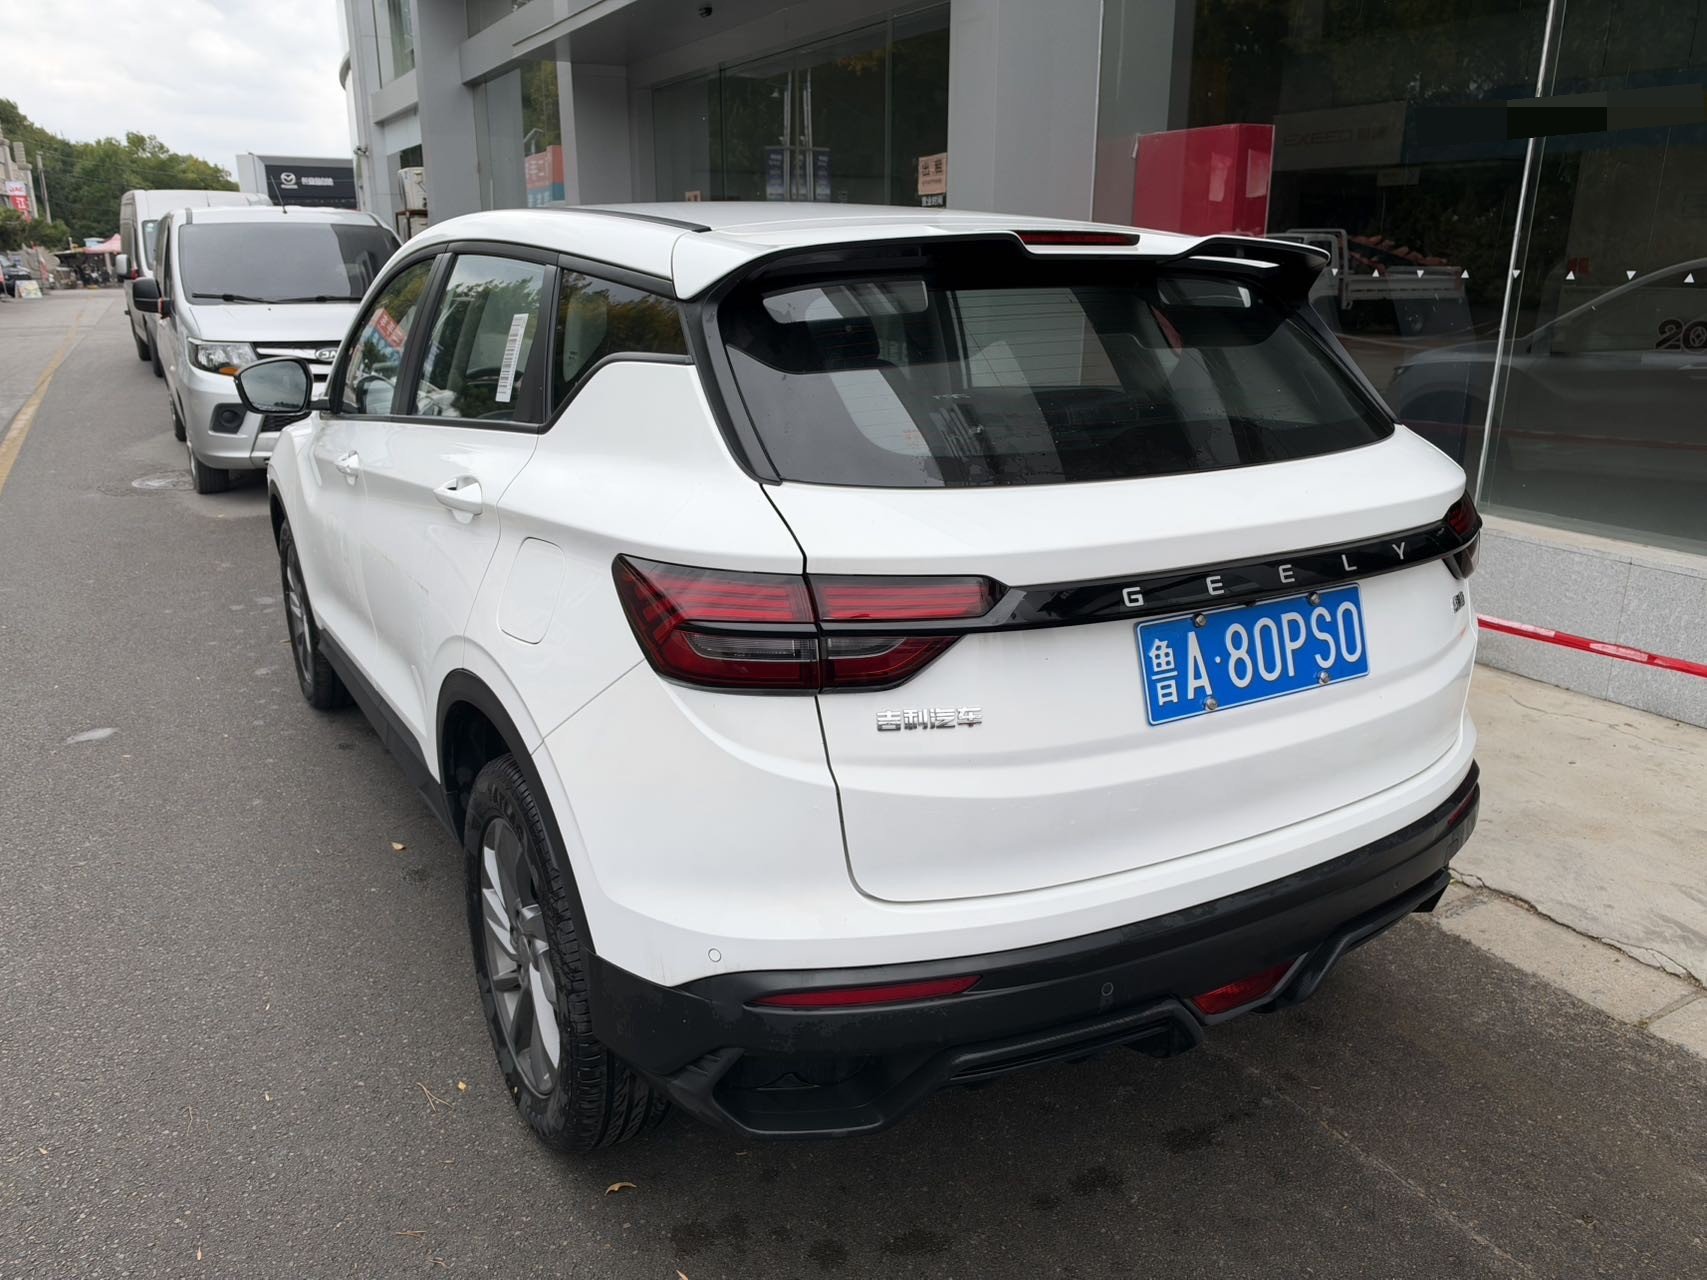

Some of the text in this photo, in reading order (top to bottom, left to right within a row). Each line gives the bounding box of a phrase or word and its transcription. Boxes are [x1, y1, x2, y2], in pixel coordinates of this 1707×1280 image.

[1122, 541, 1406, 608] GEELY
[877, 707, 982, 732] 吉利汽车
